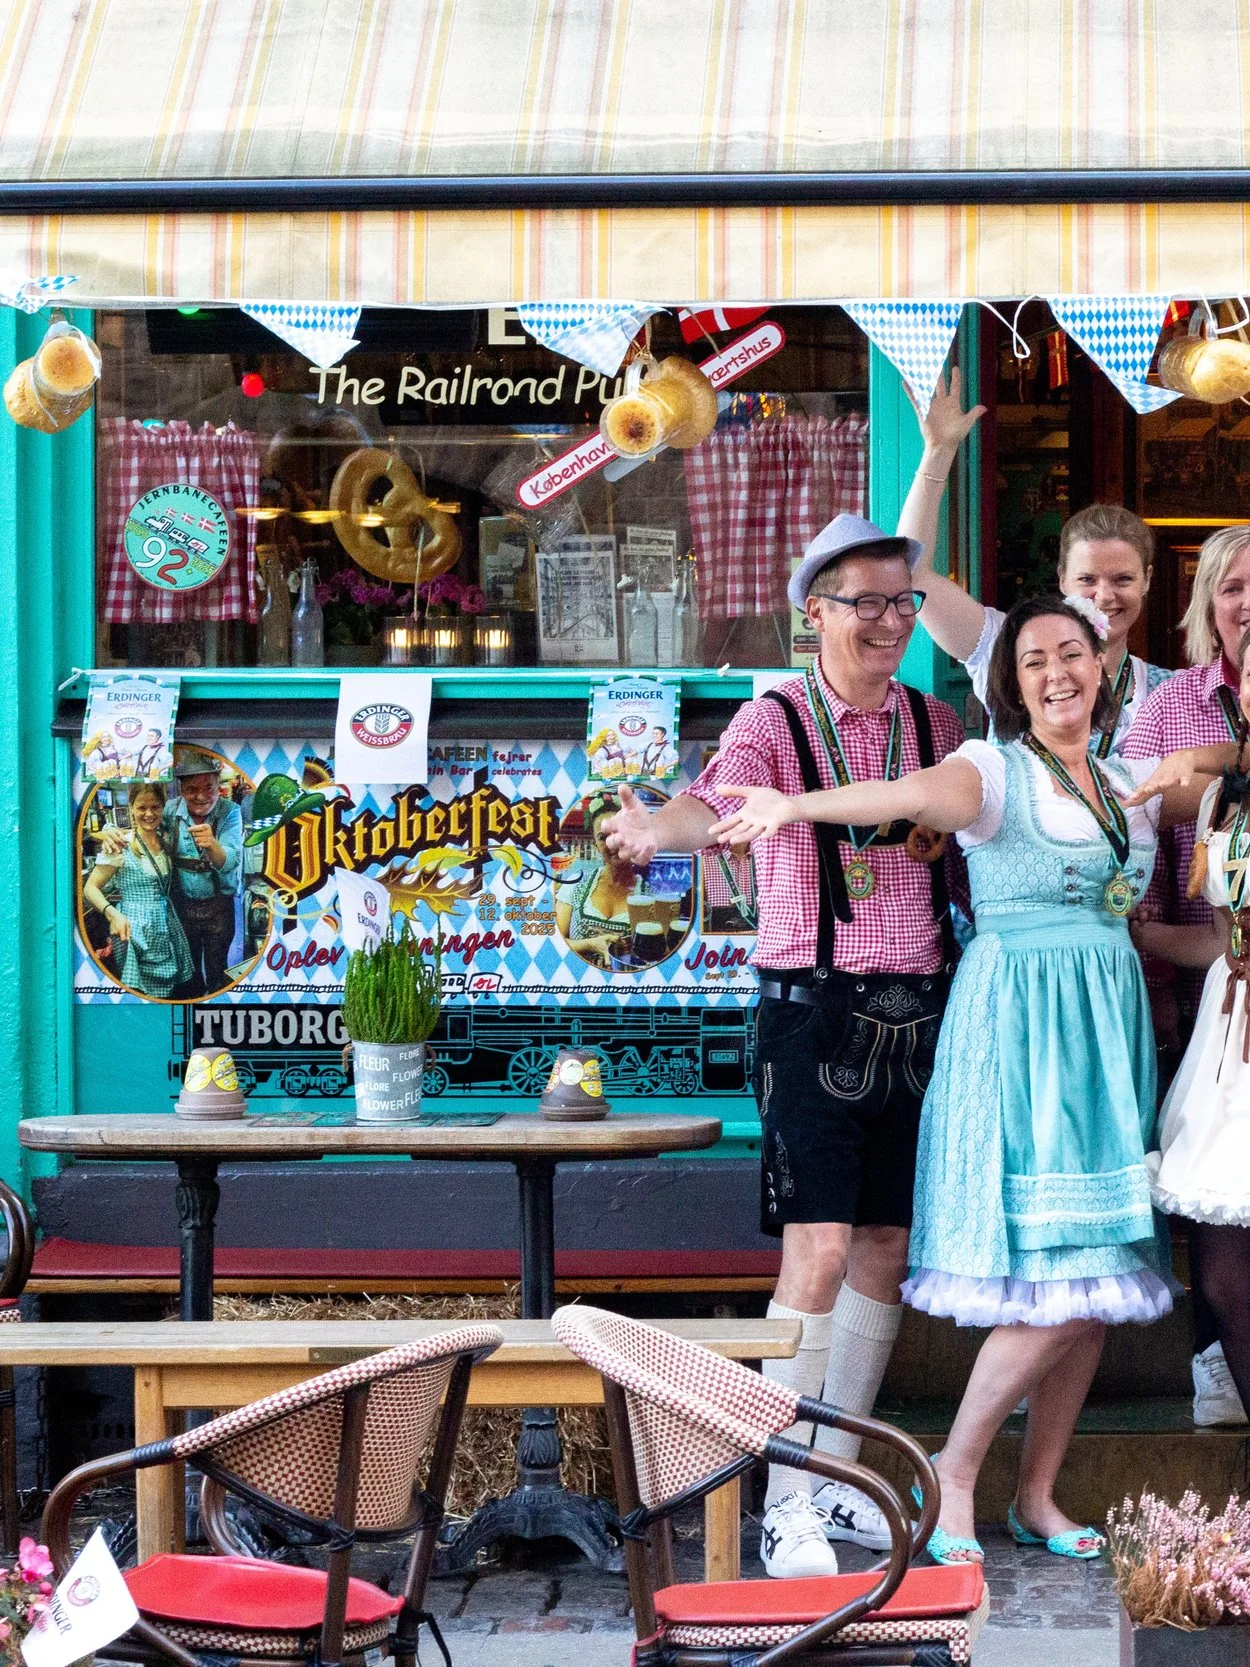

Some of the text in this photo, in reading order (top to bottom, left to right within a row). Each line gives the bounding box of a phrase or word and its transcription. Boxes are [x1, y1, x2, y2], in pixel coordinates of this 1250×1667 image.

[706, 335, 772, 388] ærtshus
[309, 364, 386, 405] The
[574, 366, 628, 405] Pu
[529, 441, 612, 500] København
[138, 485, 229, 556] JERNBANECAFEEN
[135, 536, 190, 585] 92
[107, 692, 162, 702] ERDINGER
[608, 690, 664, 700] ERDINGER
[354, 705, 411, 721] ERDINGER
[493, 751, 532, 762] fejrer
[449, 765, 473, 776] Bar
[491, 766, 543, 776] celebrates
[478, 894, 535, 908] 29. sept
[479, 909, 558, 922] 12. oktober
[521, 923, 556, 936] 2025
[266, 941, 346, 977] Oplev
[684, 941, 749, 970] Join
[194, 1009, 352, 1045] TUBORG
[399, 1048, 419, 1061] FLORE
[359, 1054, 390, 1071] FLEUR
[366, 1081, 390, 1092] FLORE
[363, 1099, 404, 1111] FLOWER
